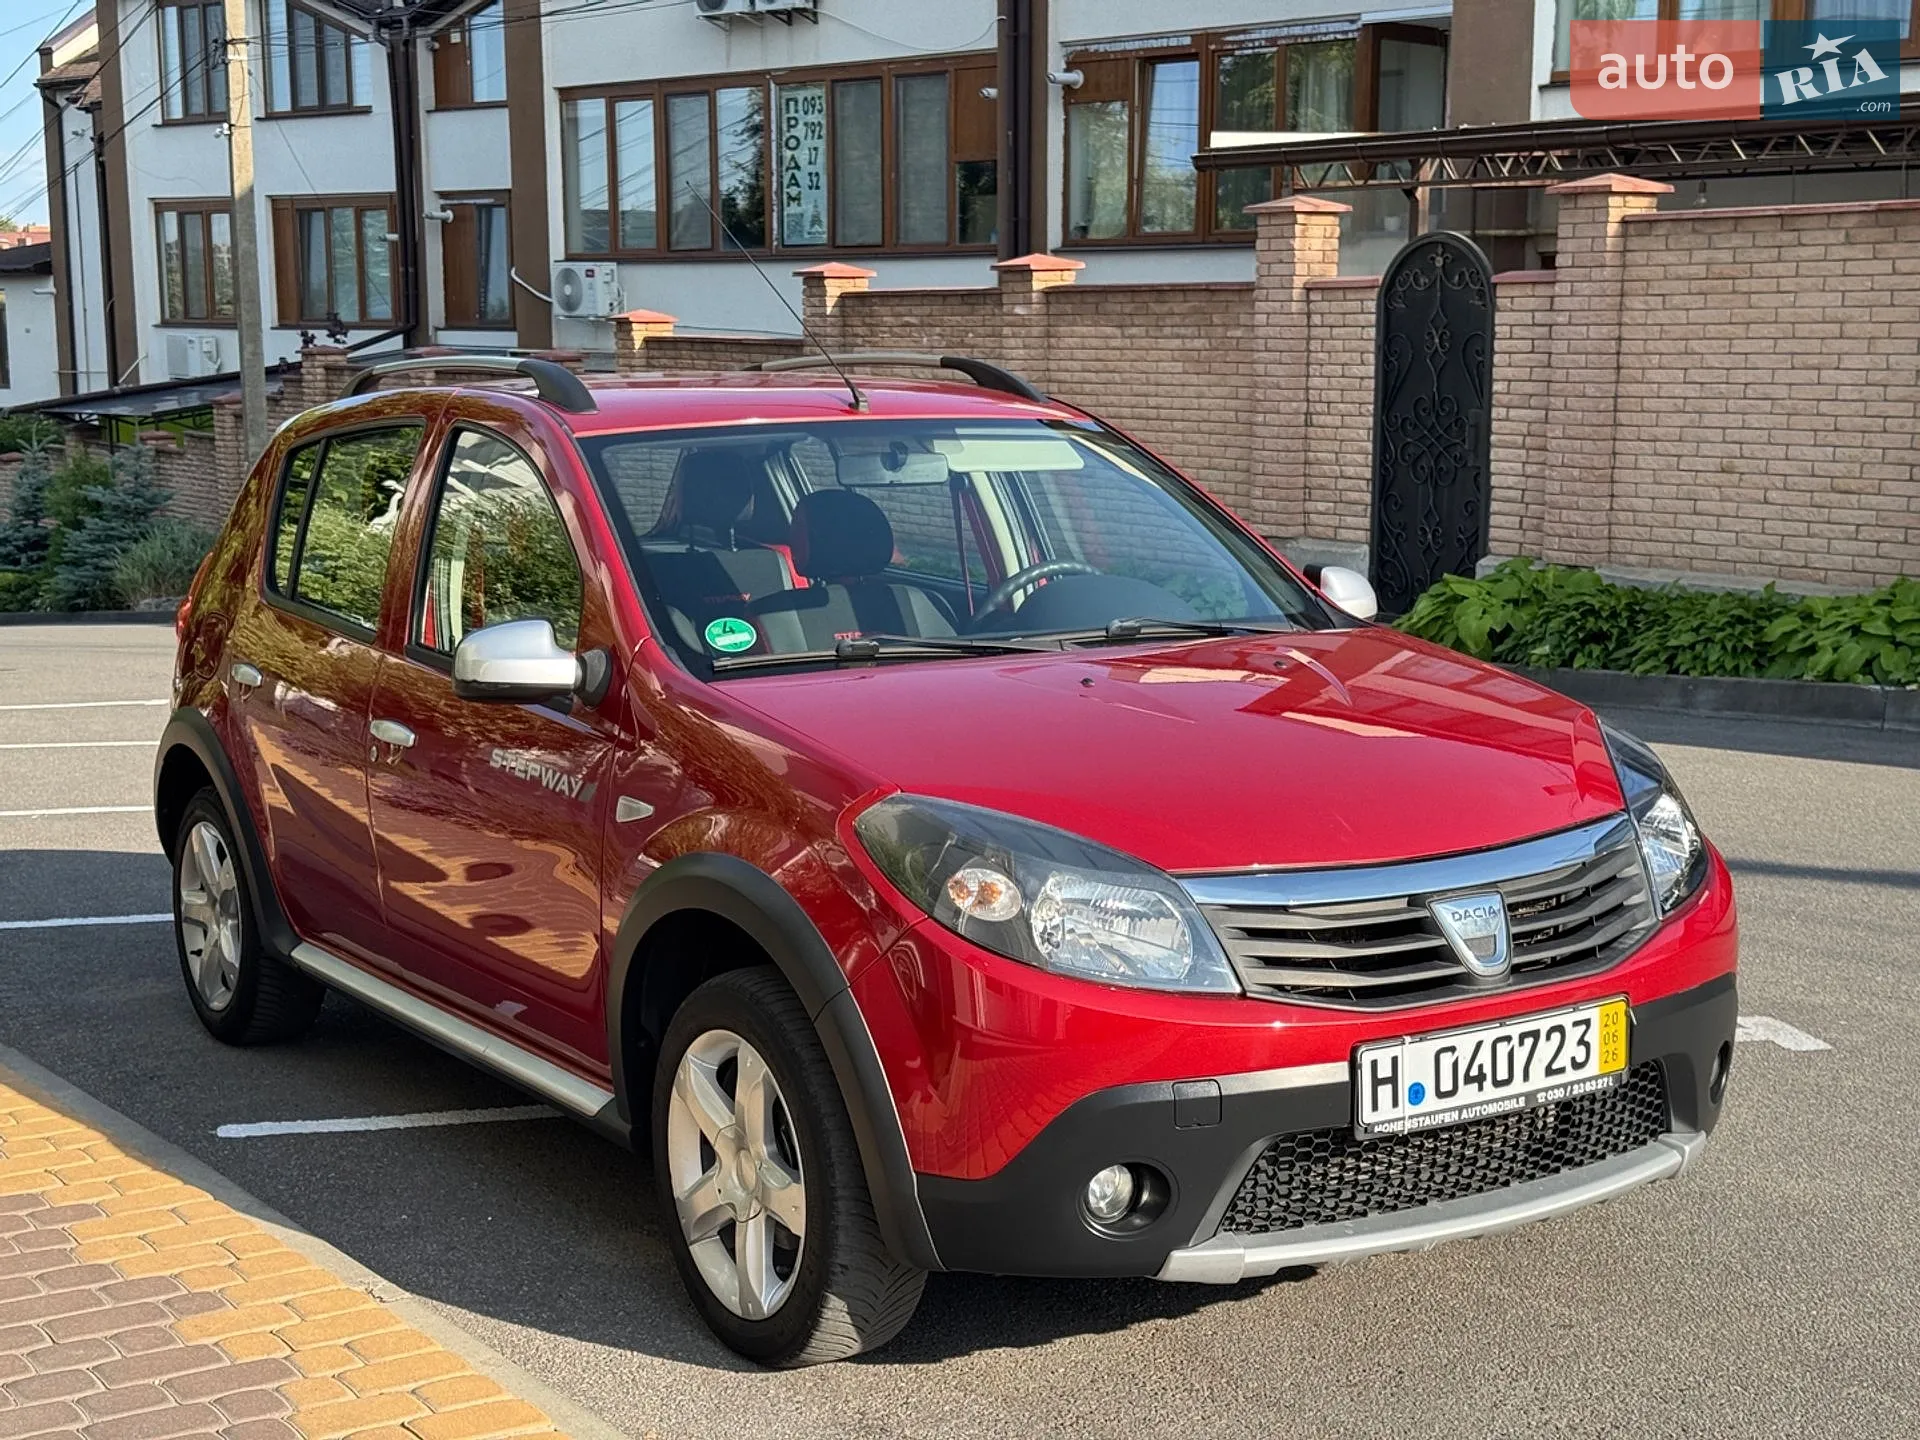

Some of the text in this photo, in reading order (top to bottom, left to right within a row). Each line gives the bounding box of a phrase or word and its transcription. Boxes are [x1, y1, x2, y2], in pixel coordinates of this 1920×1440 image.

[802, 96, 823, 115] 093
[803, 121, 823, 140] 792
[784, 97, 801, 207] ПРОДАМ
[808, 147, 819, 165] 17
[808, 172, 820, 190] 32
[722, 620, 735, 634] 4
[489, 748, 584, 798] STEPWAY
[1451, 905, 1498, 922] DACIA
[1603, 1011, 1619, 1028] 20
[1603, 1030, 1619, 1045] 06
[1603, 1048, 1618, 1064] 26
[1370, 1018, 1592, 1113] H 040723
[1374, 1110, 1459, 1133] HOHENSTAUFEN
[1460, 1097, 1526, 1119] AUTOMOBILE
[1547, 1087, 1565, 1100] 030
